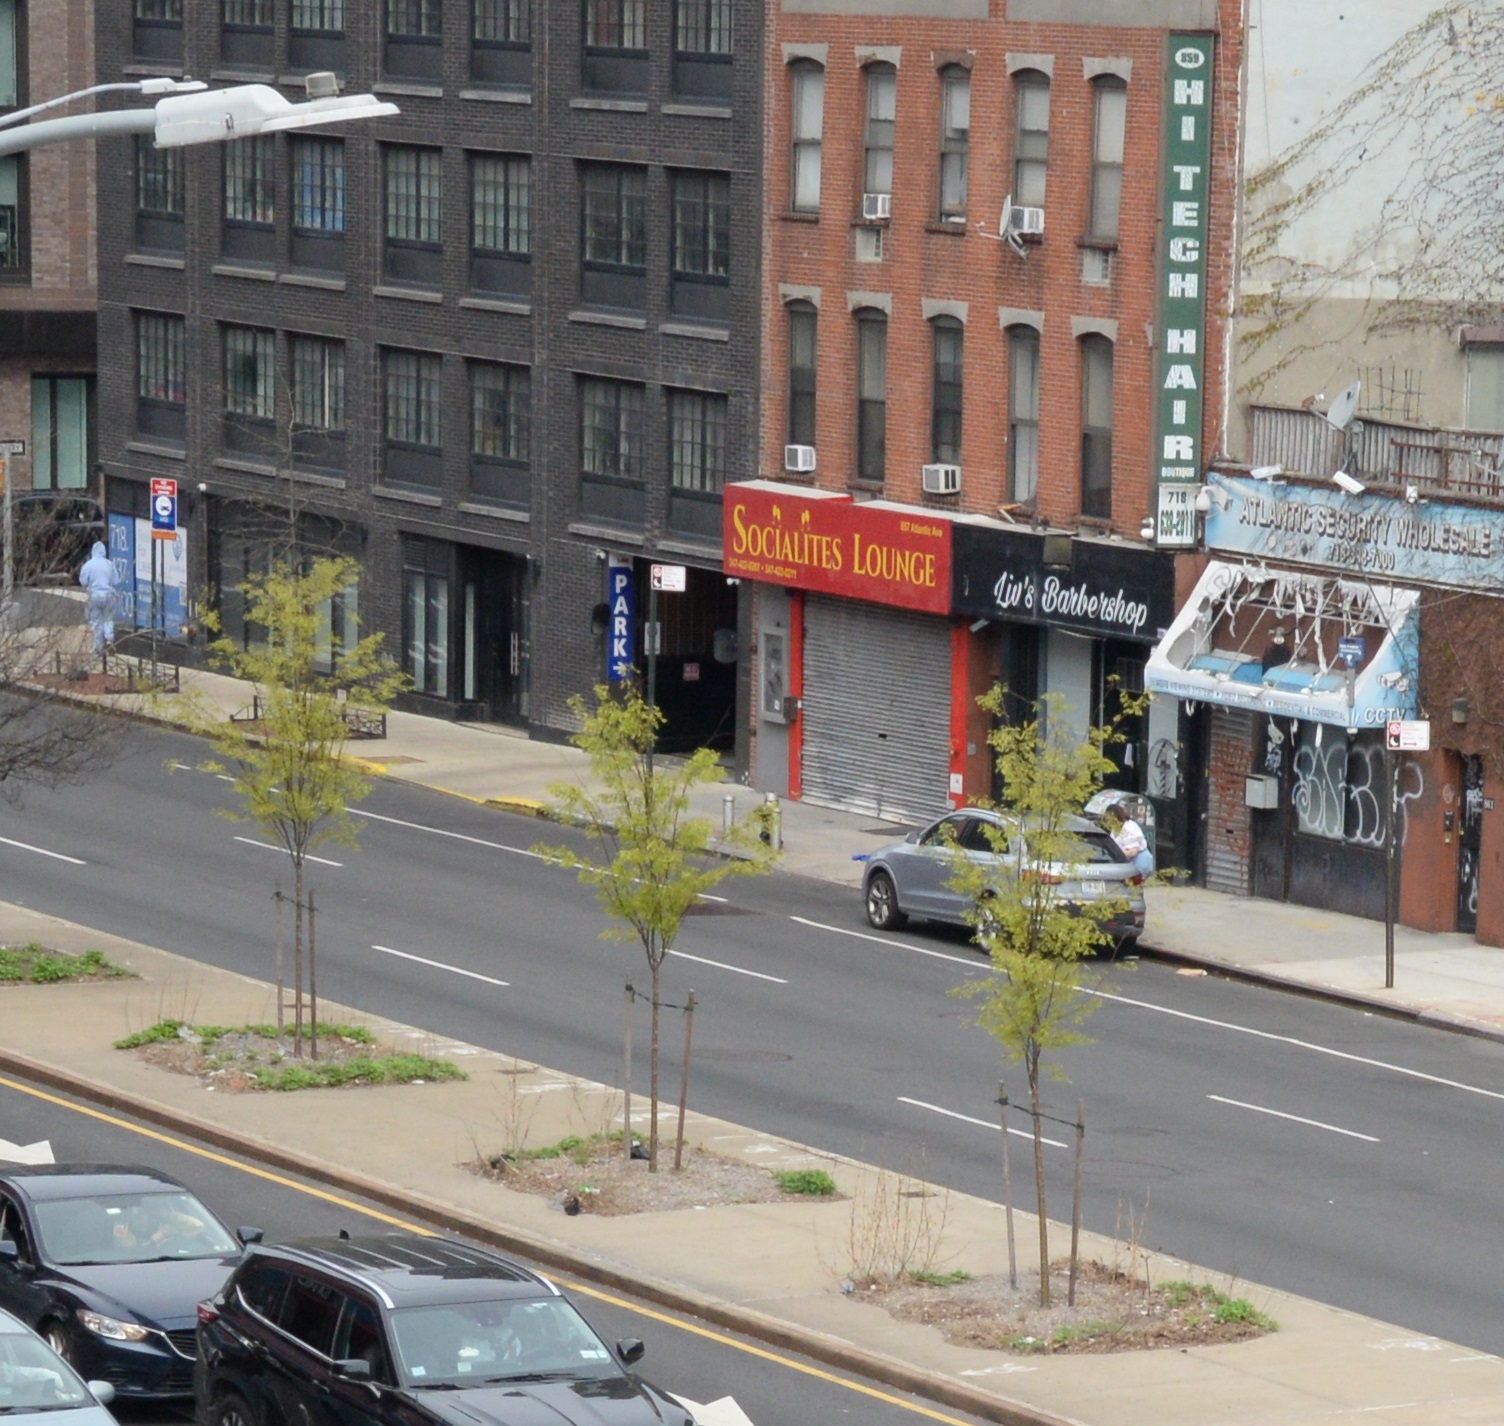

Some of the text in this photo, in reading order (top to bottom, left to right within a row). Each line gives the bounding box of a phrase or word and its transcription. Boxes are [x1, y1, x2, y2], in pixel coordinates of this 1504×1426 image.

[1181, 52, 1199, 64] 859
[1164, 79, 1204, 460] HI TECH HAIR
[1168, 492, 1186, 504] 718
[1240, 498, 1492, 559] ATLANTIC SECURITY WHOLESALE
[853, 534, 936, 587] LOUNGE
[613, 574, 628, 657] PARK
[1042, 576, 1147, 635] Barbershop
[1364, 706, 1406, 724] CCTV
